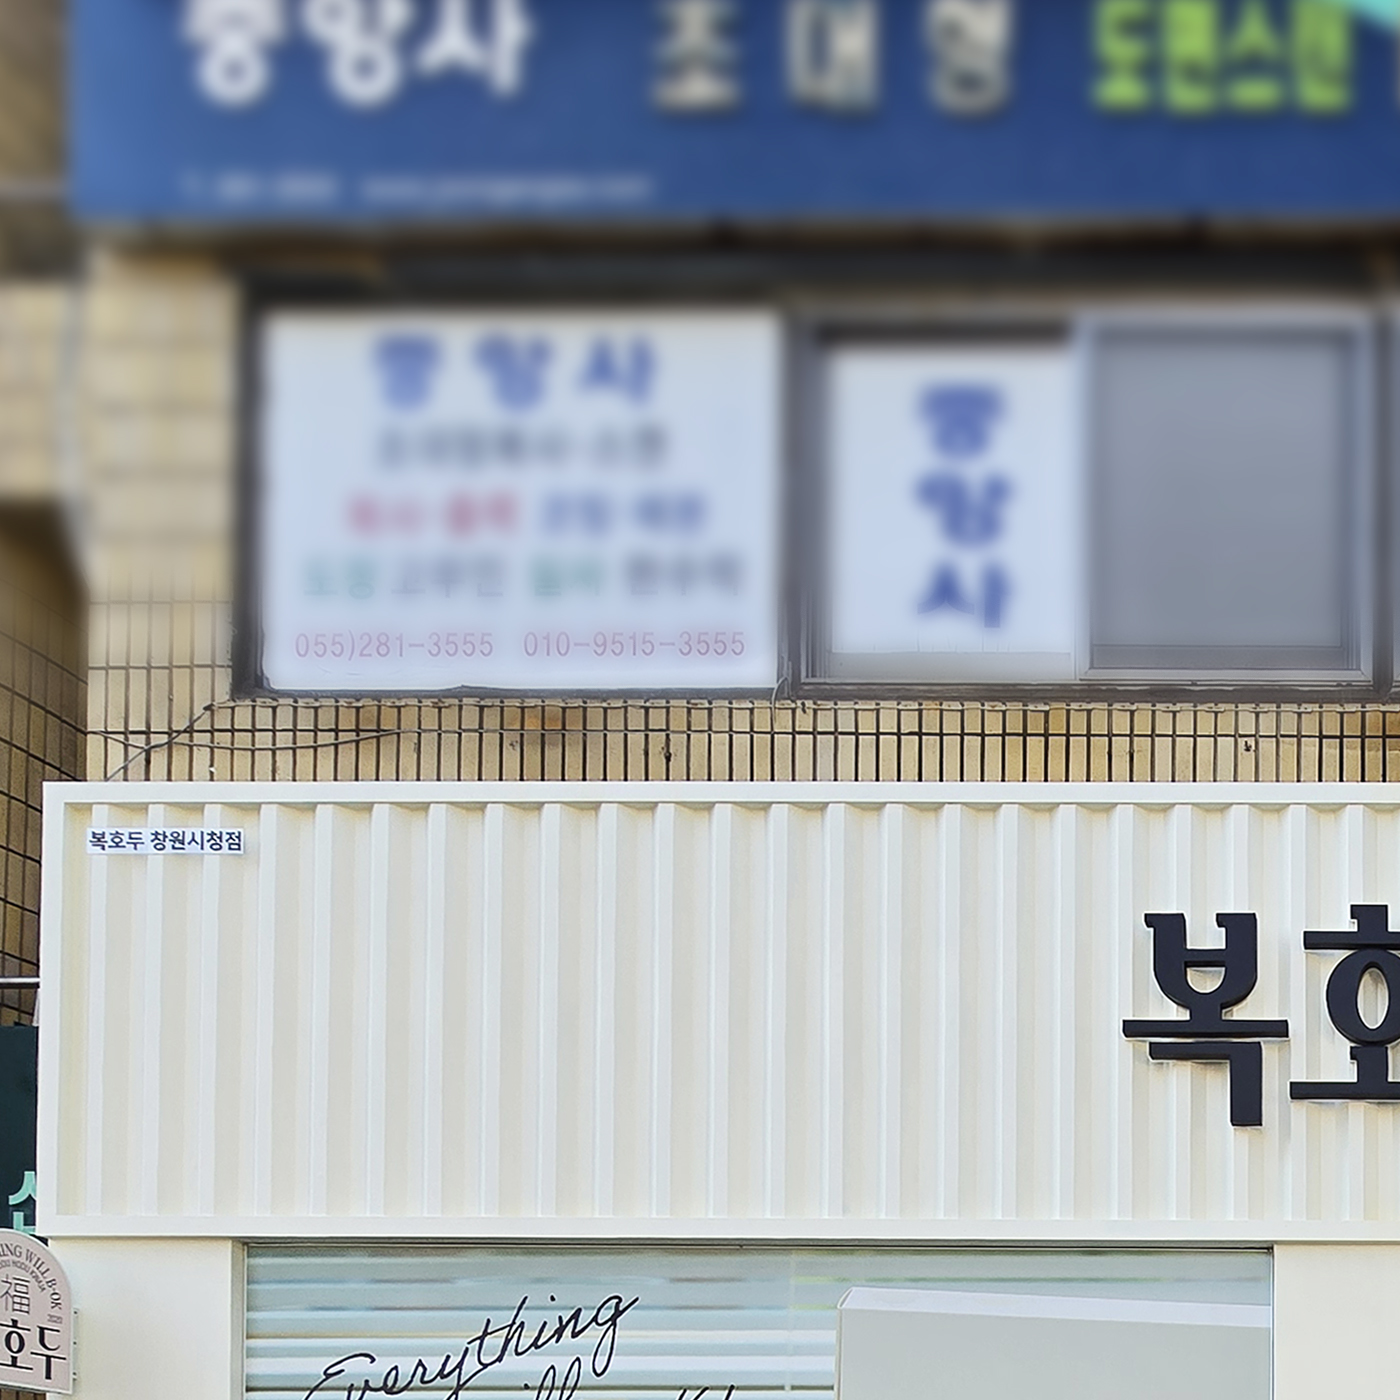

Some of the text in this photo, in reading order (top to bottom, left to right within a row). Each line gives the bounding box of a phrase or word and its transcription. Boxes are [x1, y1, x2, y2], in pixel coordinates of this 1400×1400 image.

[294, 629, 747, 661] 055)281-3555 010-9515-3555
[89, 829, 243, 851] 복호두 창원시청점
[0, 1242, 23, 1259] ING
[25, 1248, 51, 1280] WILL
[0, 1273, 31, 1315] 福
